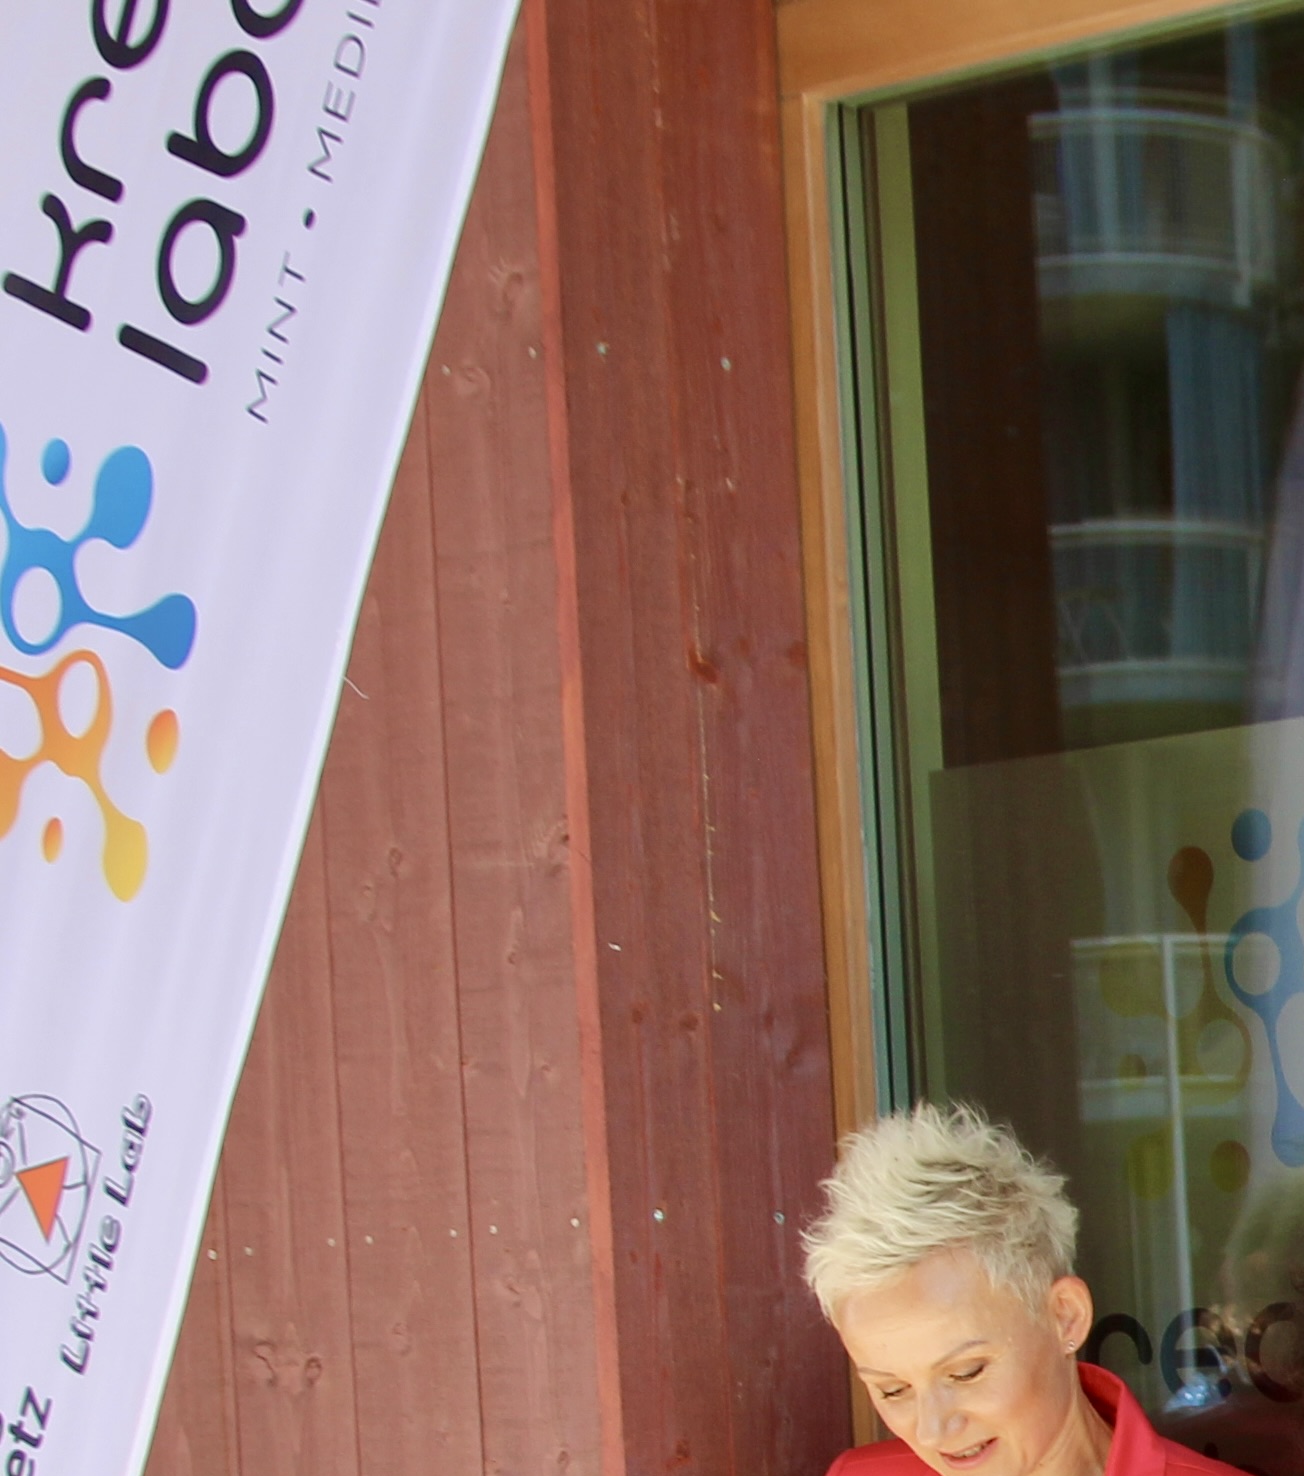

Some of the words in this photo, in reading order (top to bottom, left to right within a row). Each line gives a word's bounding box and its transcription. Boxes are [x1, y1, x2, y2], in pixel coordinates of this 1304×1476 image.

[246, 252, 306, 424] MINT
[307, 0, 380, 183] MEDI
[59, 1215, 121, 1375] Little
[103, 1093, 152, 1208] Lab
